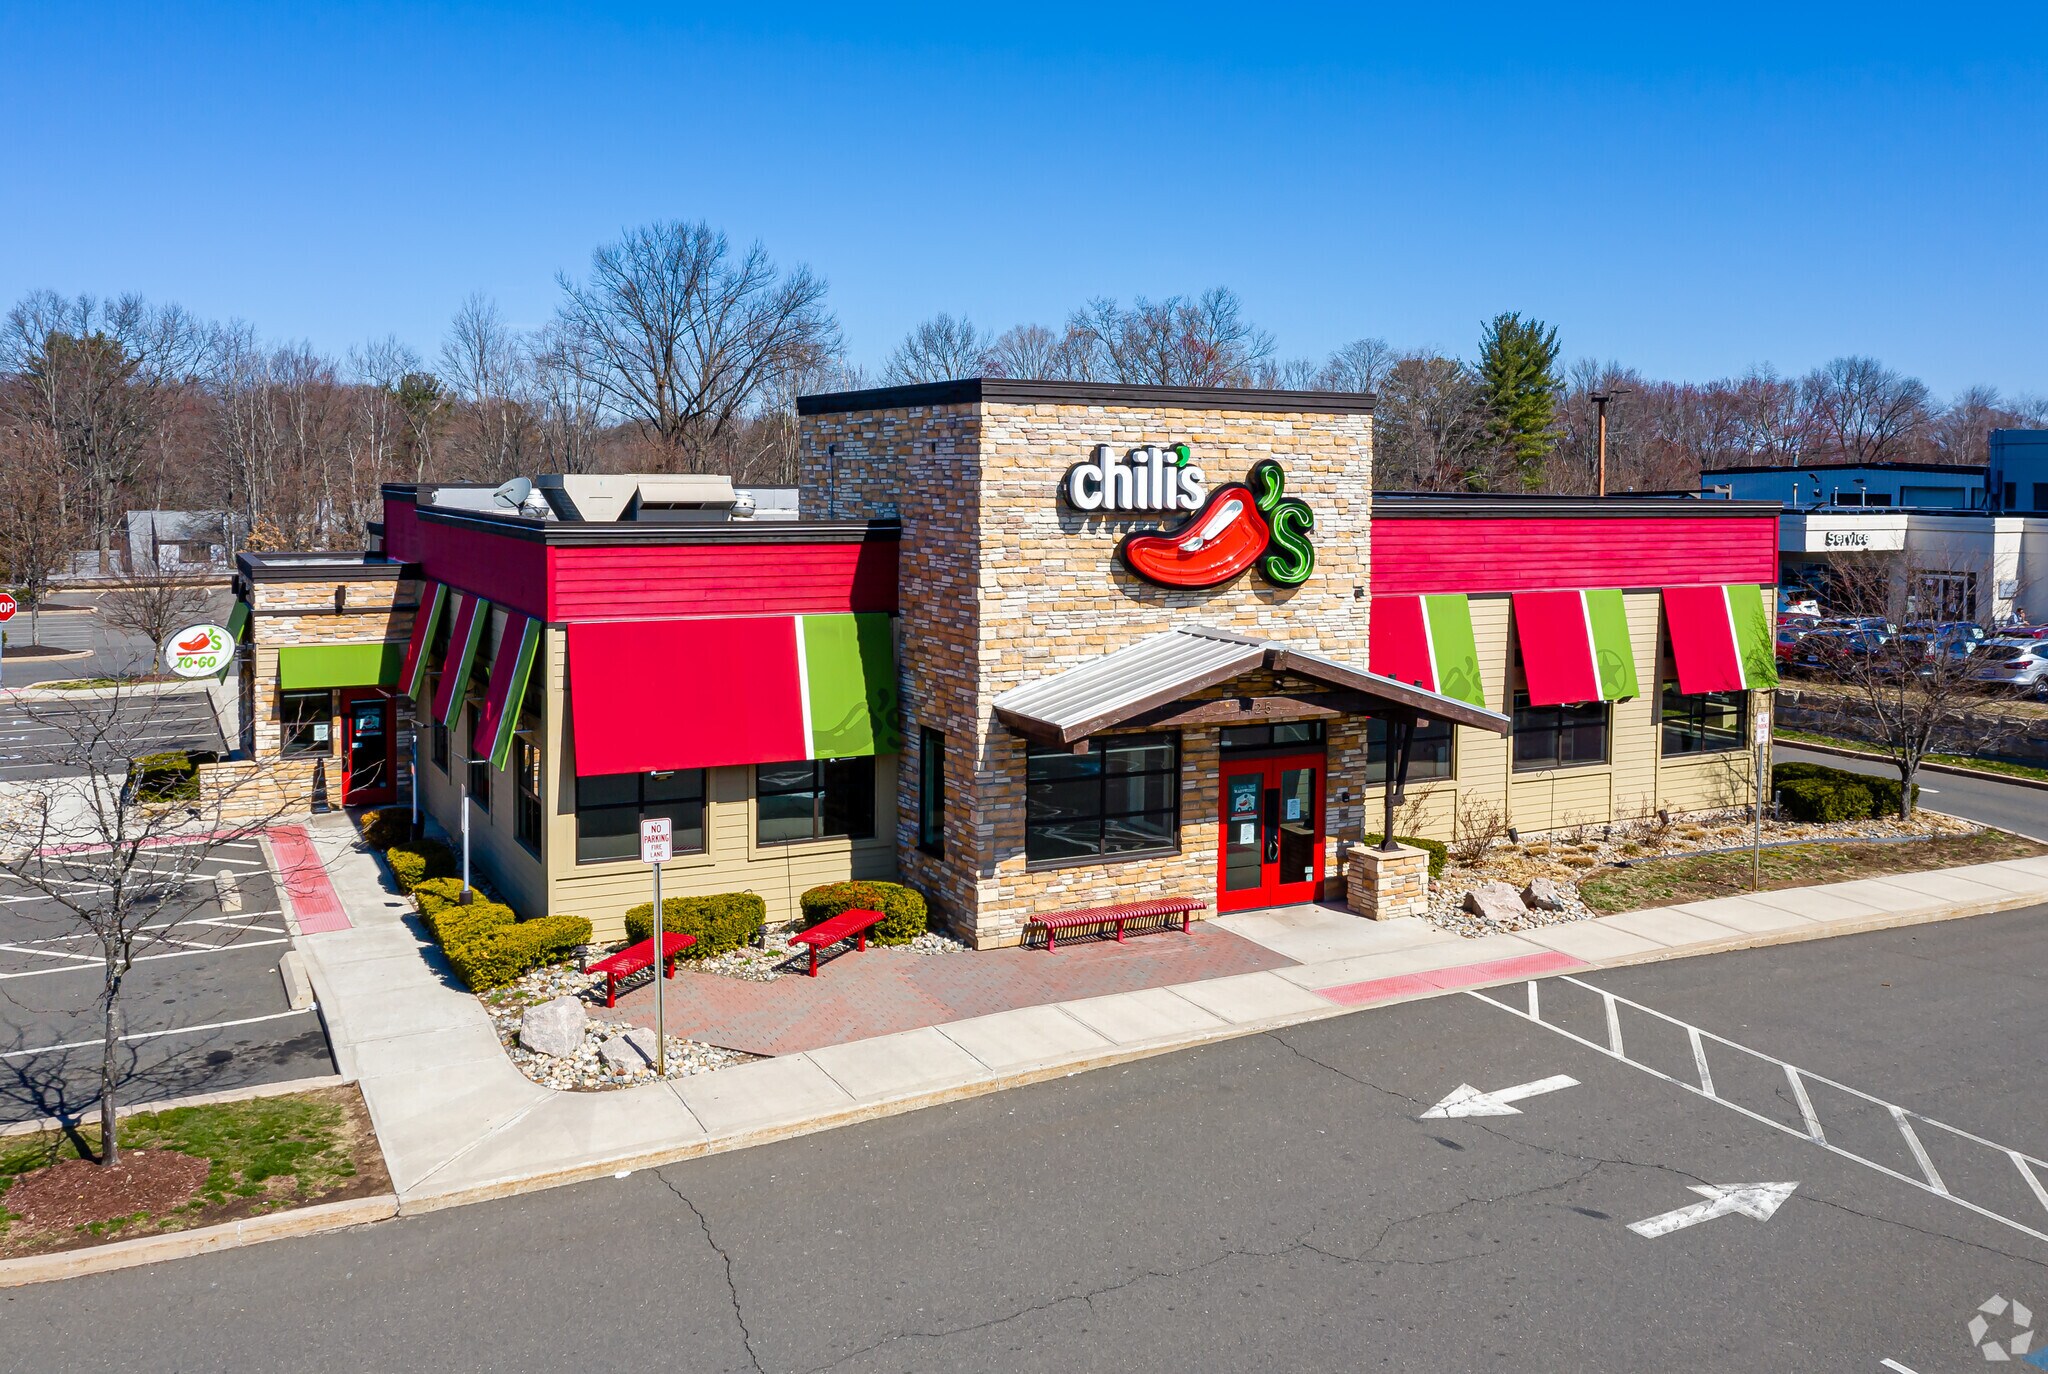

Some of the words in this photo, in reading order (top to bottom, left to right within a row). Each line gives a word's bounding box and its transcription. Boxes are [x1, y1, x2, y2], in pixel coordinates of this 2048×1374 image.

[1072, 445, 1206, 511] chili's
[1826, 532, 1869, 546] Service
[0, 602, 15, 613] OP
[651, 825, 661, 833] NO
[644, 834, 669, 843] PARKING
